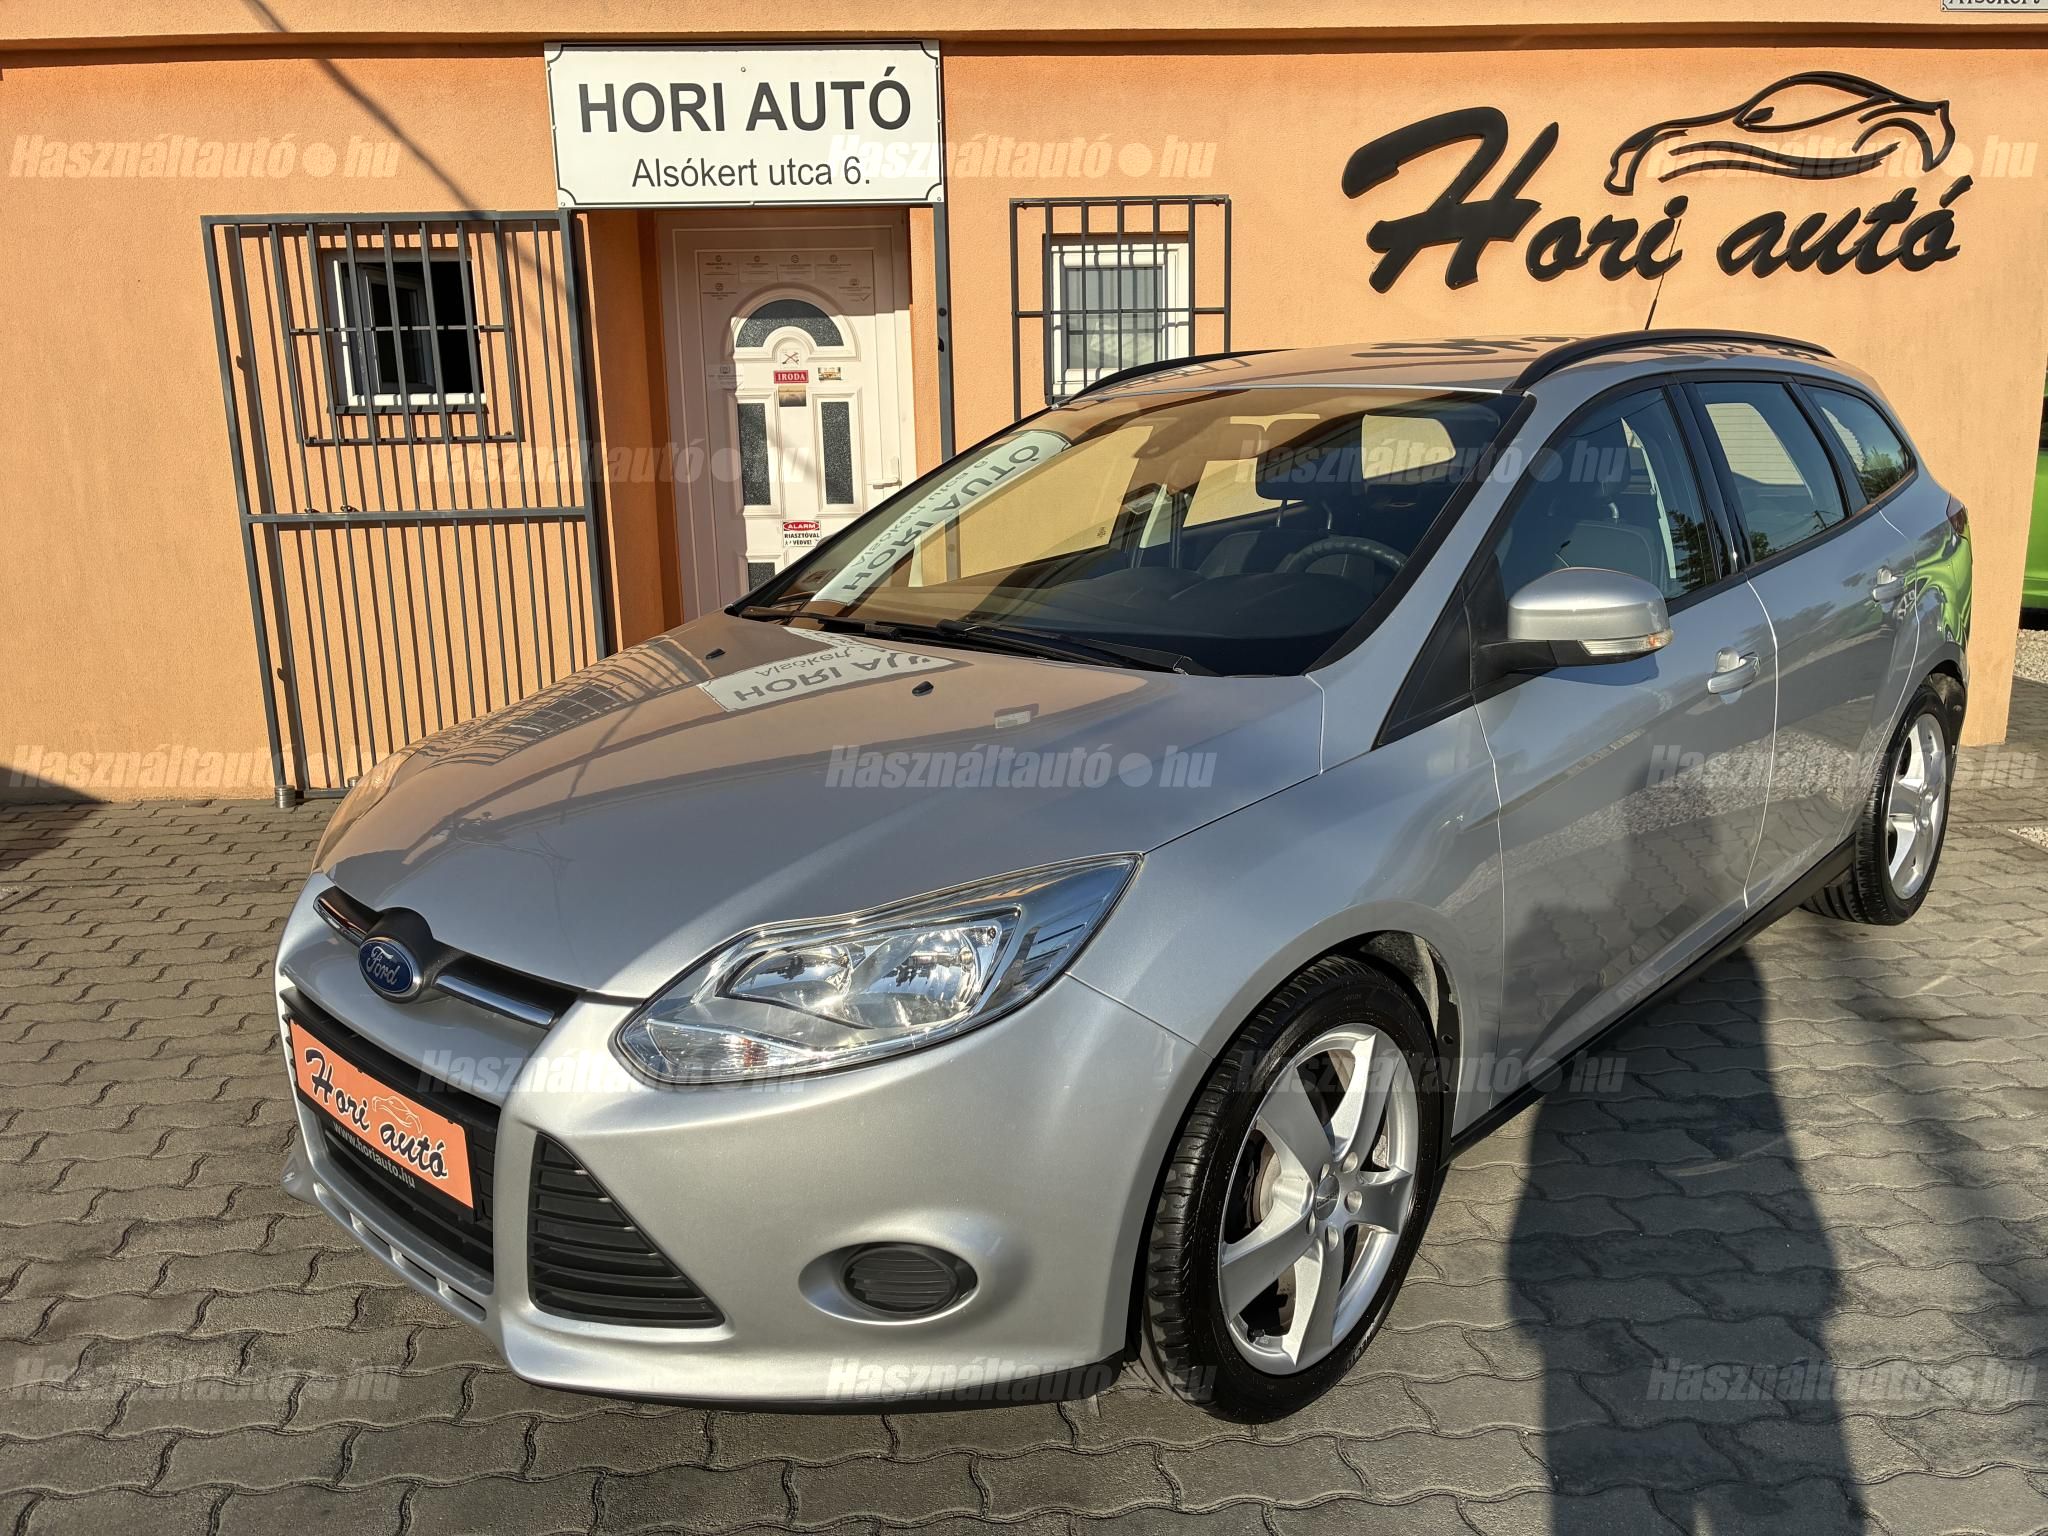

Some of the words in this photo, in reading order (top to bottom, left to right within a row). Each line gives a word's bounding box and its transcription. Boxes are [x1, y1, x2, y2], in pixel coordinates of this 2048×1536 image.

[579, 82, 725, 133] HORI
[745, 66, 911, 132] AUTÓ
[632, 158, 758, 188] Alsókert
[768, 160, 832, 186] utca
[842, 156, 871, 184] 6.
[1341, 105, 1690, 293] Hori
[1716, 174, 1974, 278] autó
[777, 372, 806, 381] IRODA
[366, 946, 401, 985] Ford
[305, 1047, 371, 1134] Hori
[378, 1121, 449, 1179] autó
[333, 1122, 416, 1190] www.horiauto.hu
